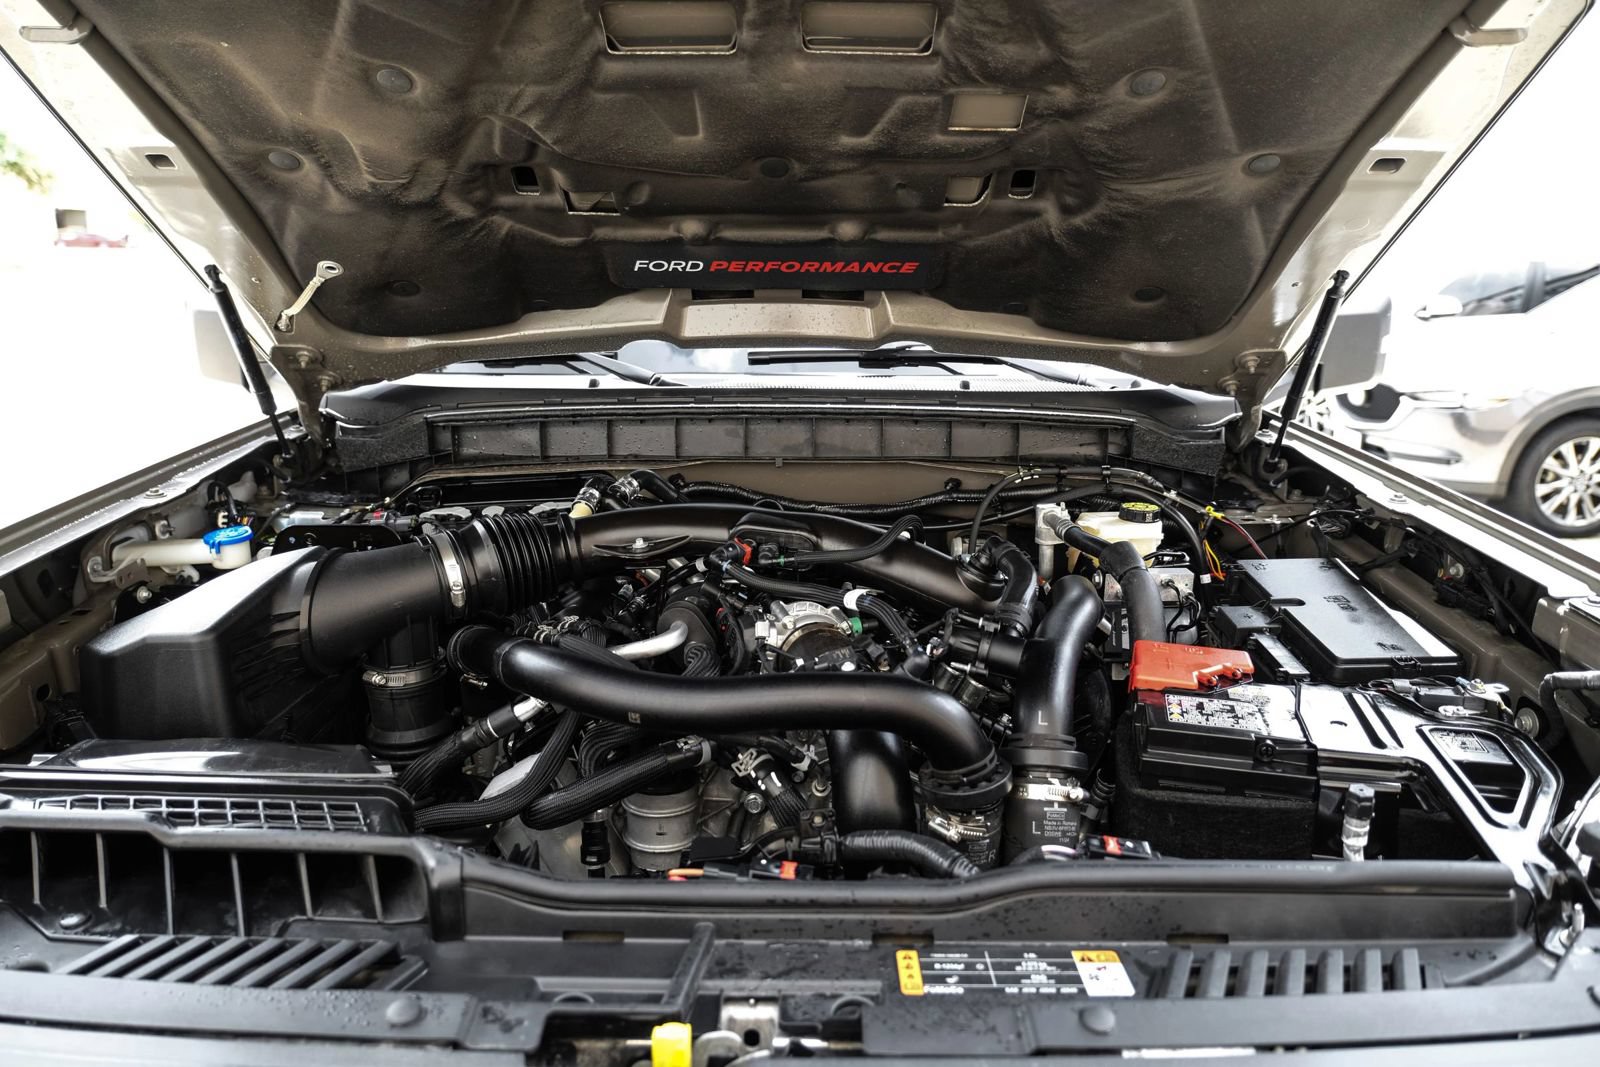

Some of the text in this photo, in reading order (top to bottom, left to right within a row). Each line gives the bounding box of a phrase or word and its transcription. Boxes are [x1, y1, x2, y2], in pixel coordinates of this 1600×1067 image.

[633, 260, 920, 274] FORD PERFORMANCE
[1037, 710, 1048, 725] L
[1032, 821, 1041, 834] L
